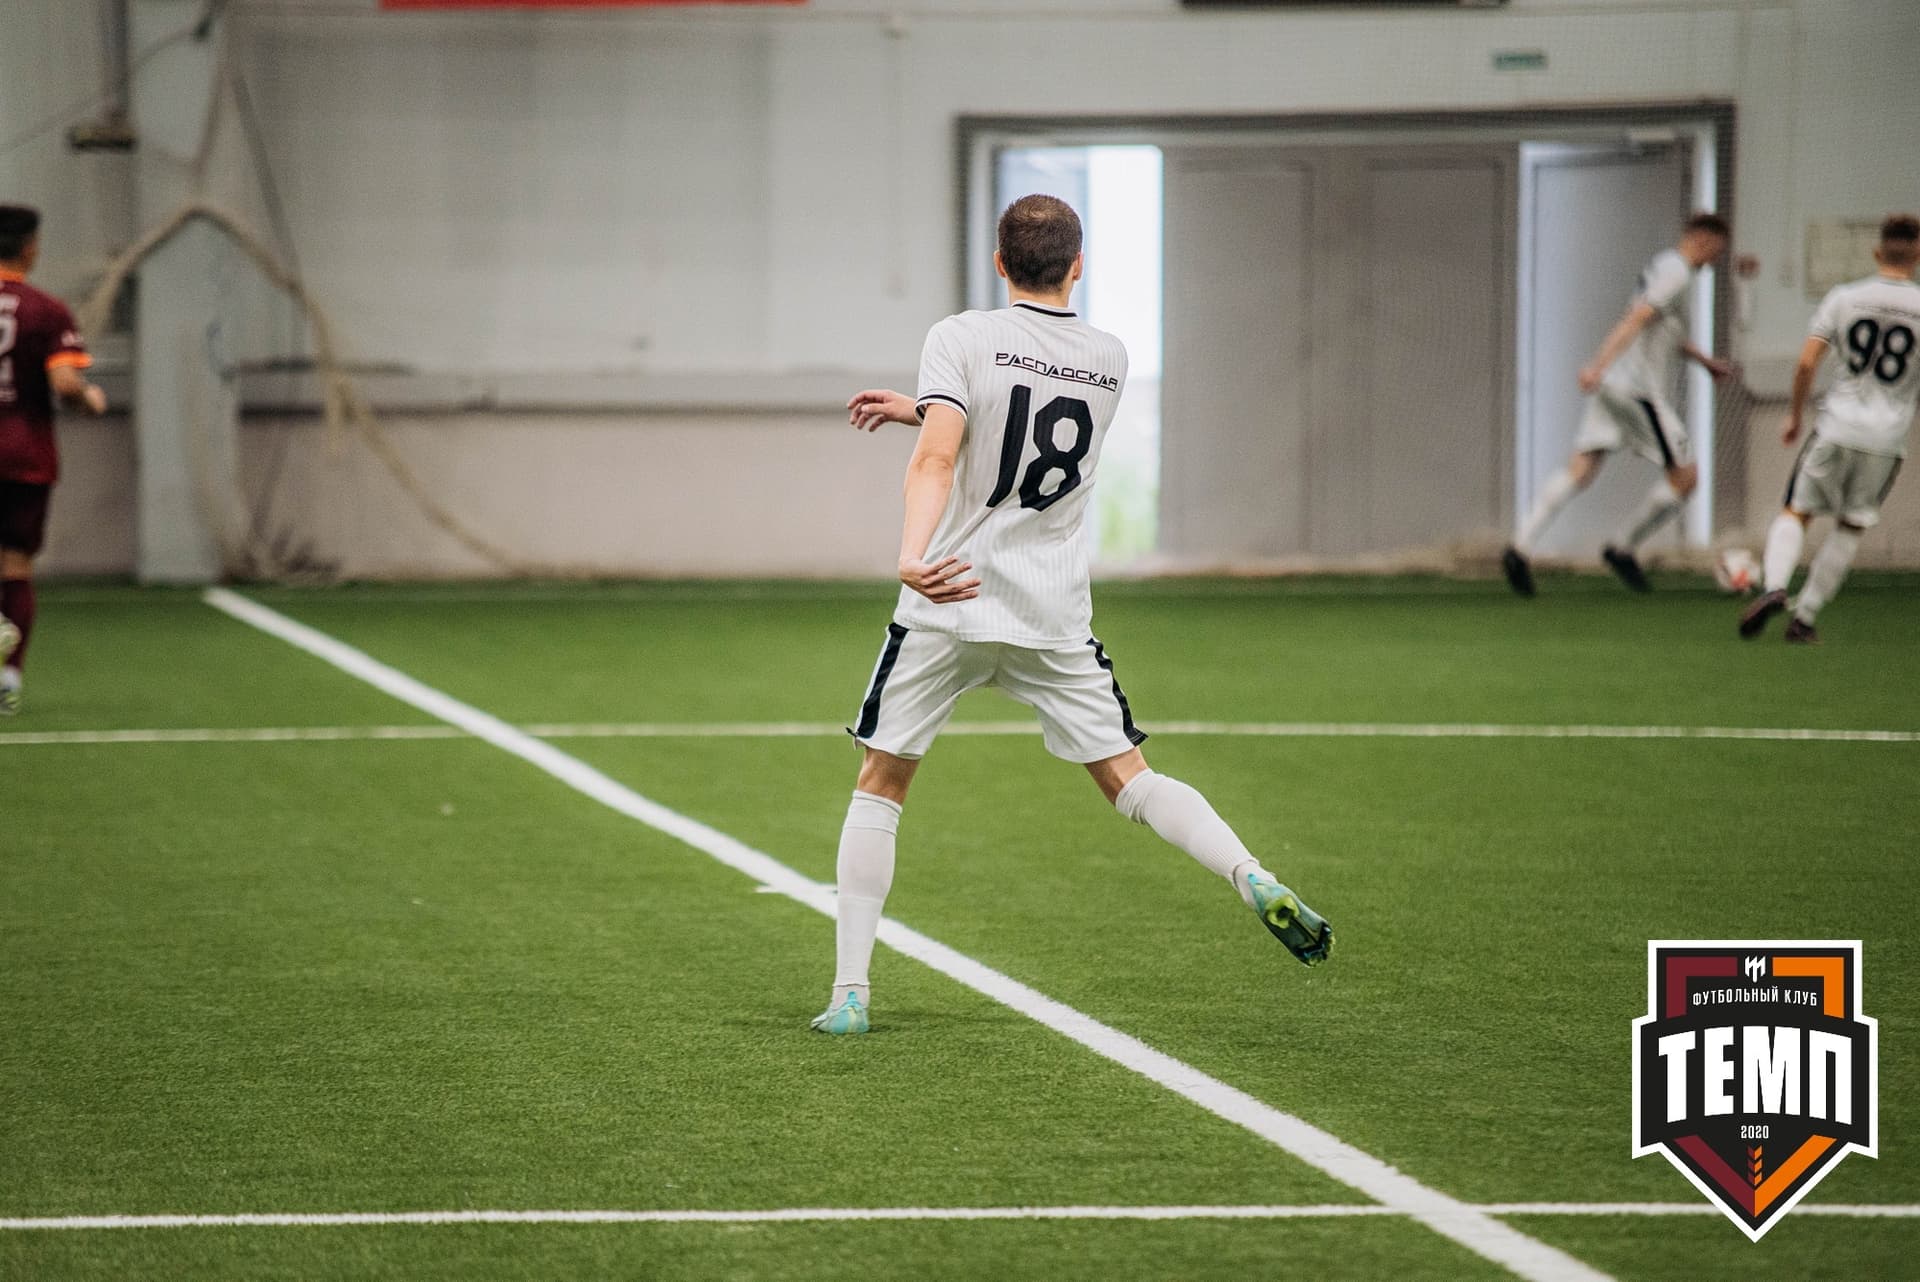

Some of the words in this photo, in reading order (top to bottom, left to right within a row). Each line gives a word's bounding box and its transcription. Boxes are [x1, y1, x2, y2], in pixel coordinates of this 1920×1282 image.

[995, 352, 1119, 392] РАСПАДСКАЯ
[1847, 318, 1915, 383] 98
[986, 384, 1094, 512] 18
